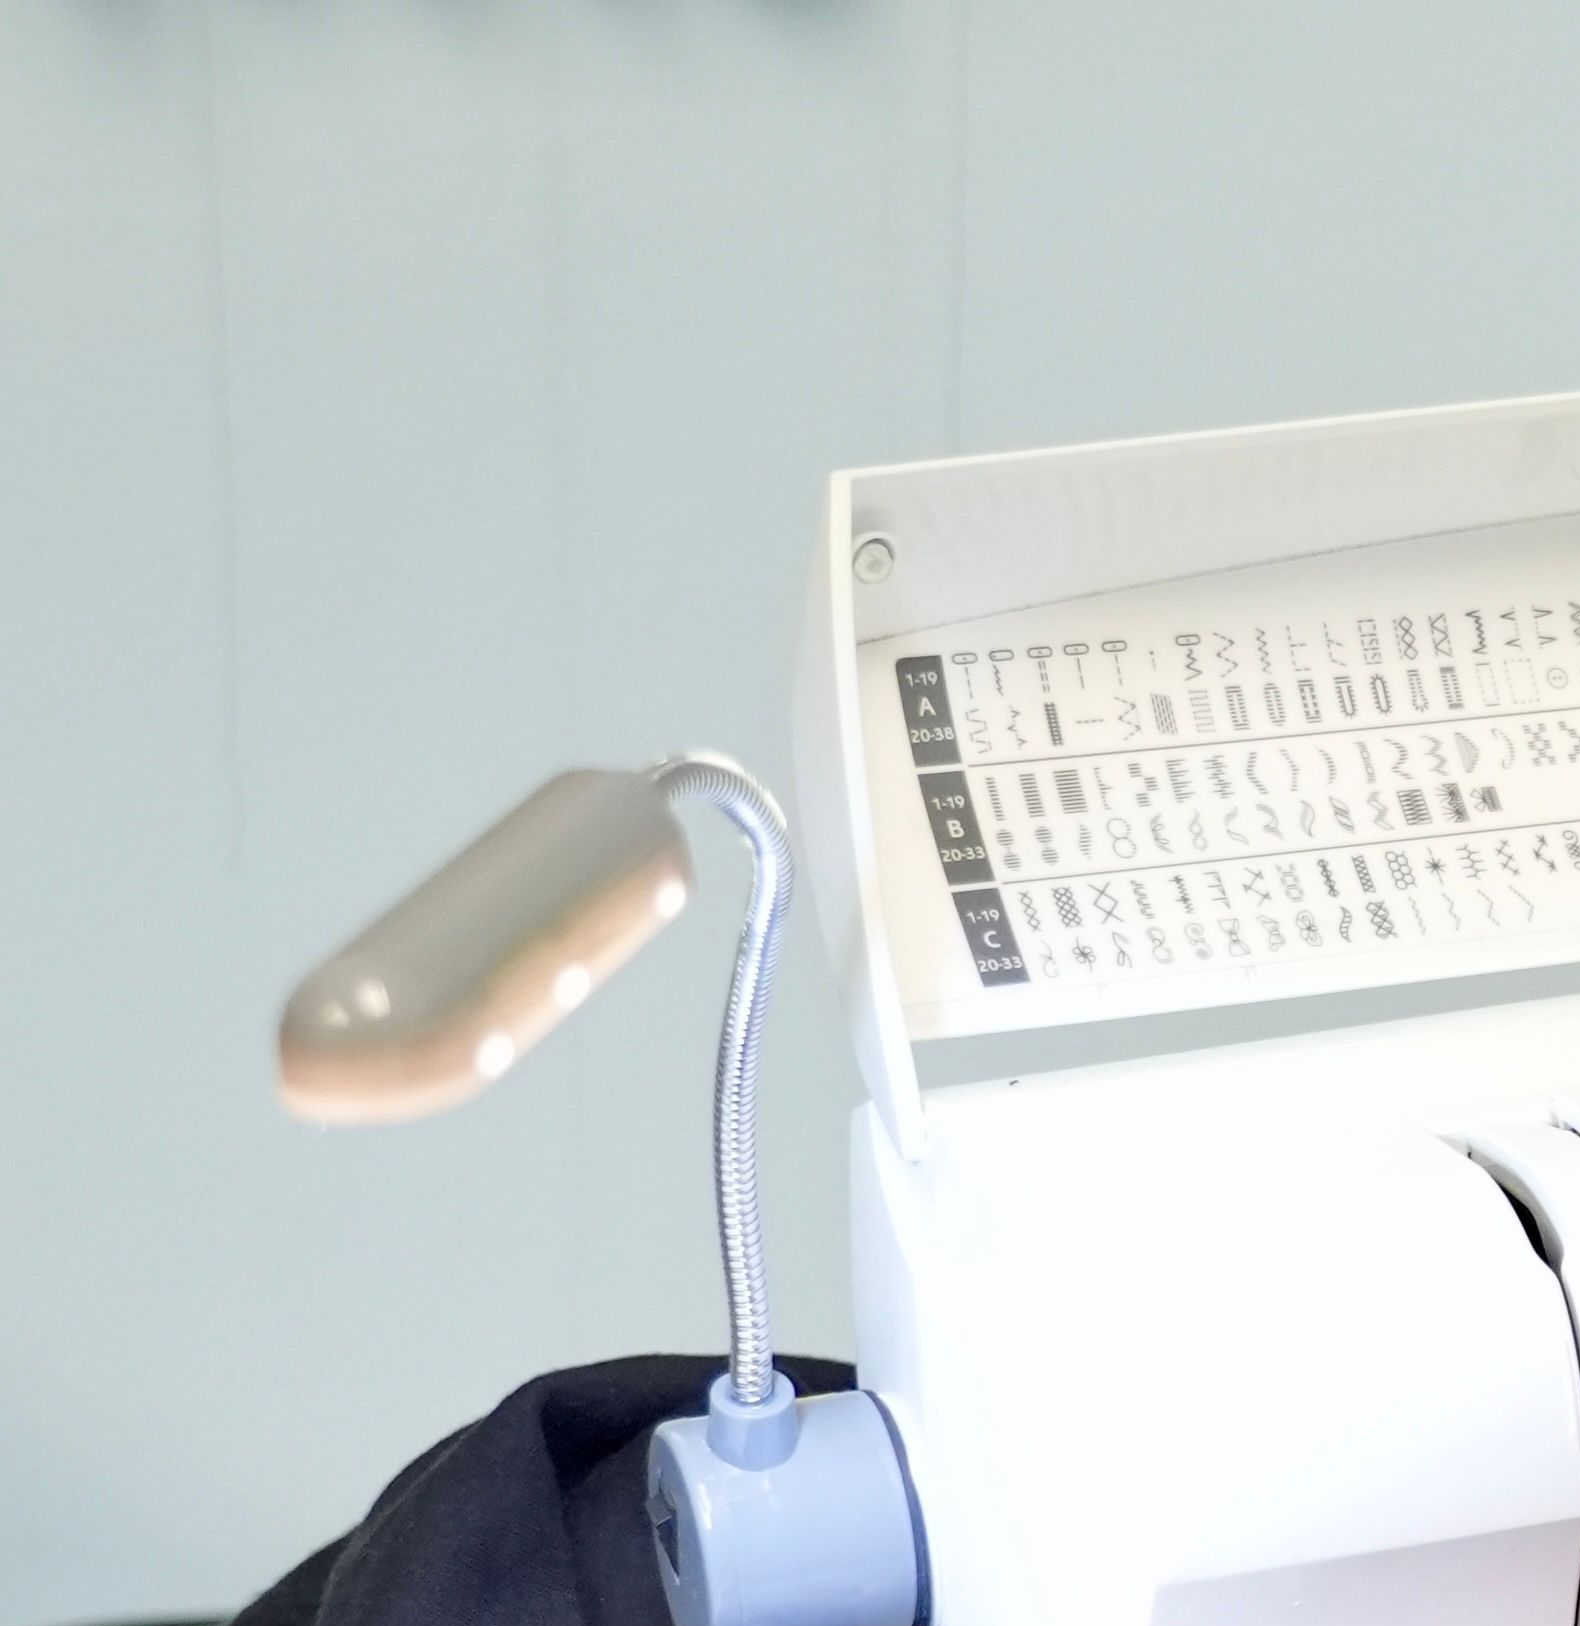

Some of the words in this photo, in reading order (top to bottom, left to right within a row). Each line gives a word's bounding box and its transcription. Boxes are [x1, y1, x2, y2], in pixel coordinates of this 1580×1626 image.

[905, 672, 938, 687] 1-19
[919, 696, 936, 718] A
[910, 727, 954, 744] 20-38
[932, 796, 965, 811] 1-19
[946, 820, 965, 838] B
[940, 847, 986, 863] 20-33
[966, 909, 1000, 924] 1-19
[983, 930, 1001, 948] C
[977, 956, 1022, 973] 20-33
